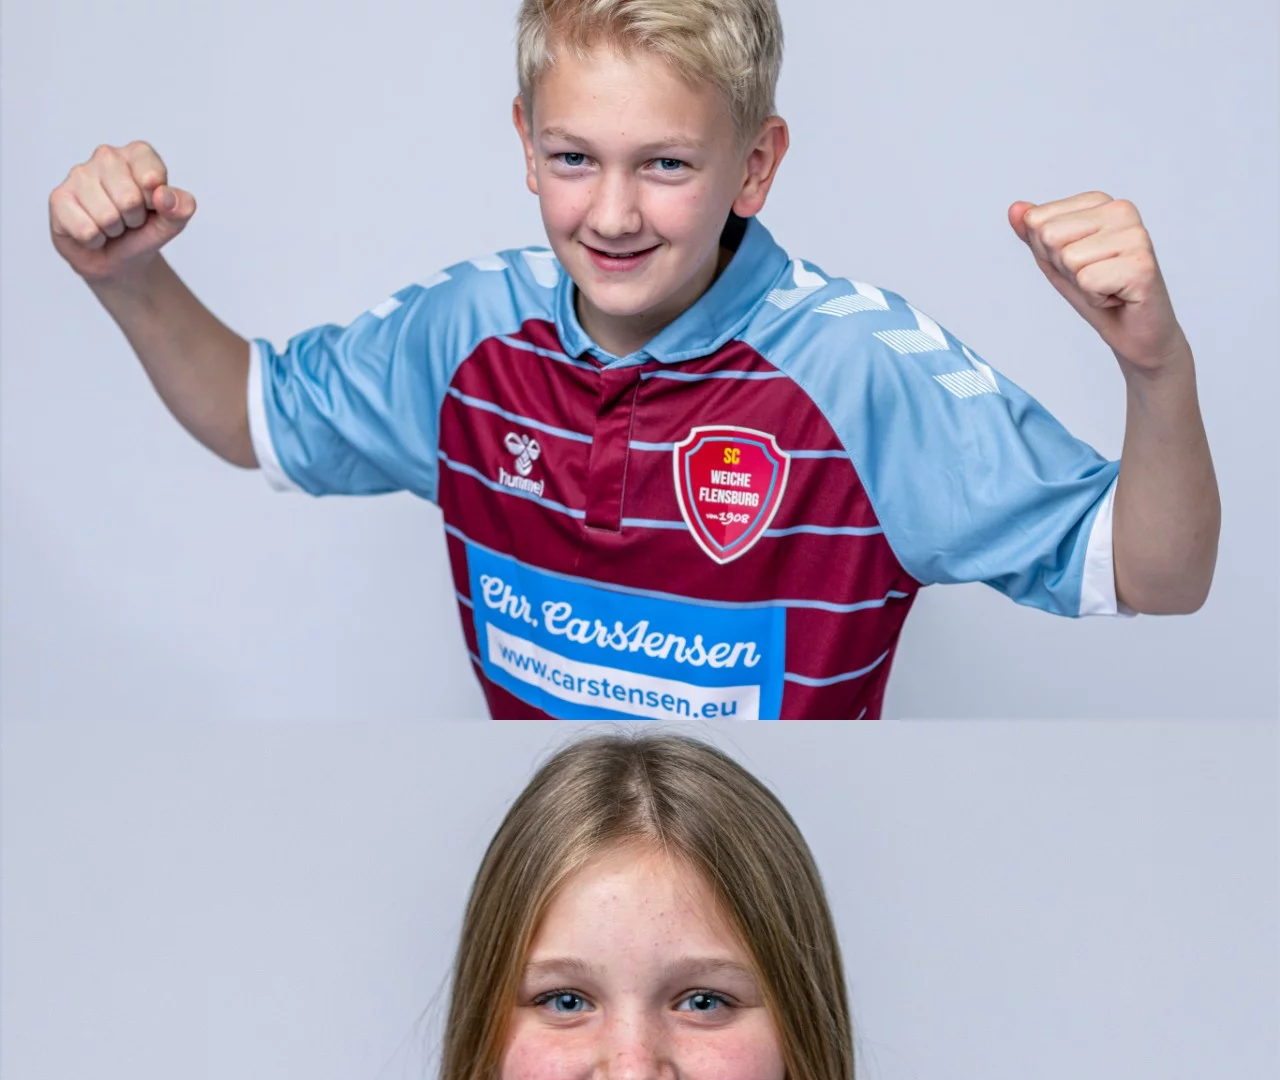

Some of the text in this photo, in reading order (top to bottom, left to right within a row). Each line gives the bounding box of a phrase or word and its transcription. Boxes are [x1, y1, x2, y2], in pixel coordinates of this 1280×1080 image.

[723, 447, 741, 465] SC
[499, 467, 544, 497] hummel
[711, 469, 752, 488] WEICHE
[699, 487, 759, 507] FLENSBURG
[719, 512, 750, 525] 1908
[480, 573, 761, 669] Chr. Carstensen
[498, 643, 737, 719] www.carstensen.eu
